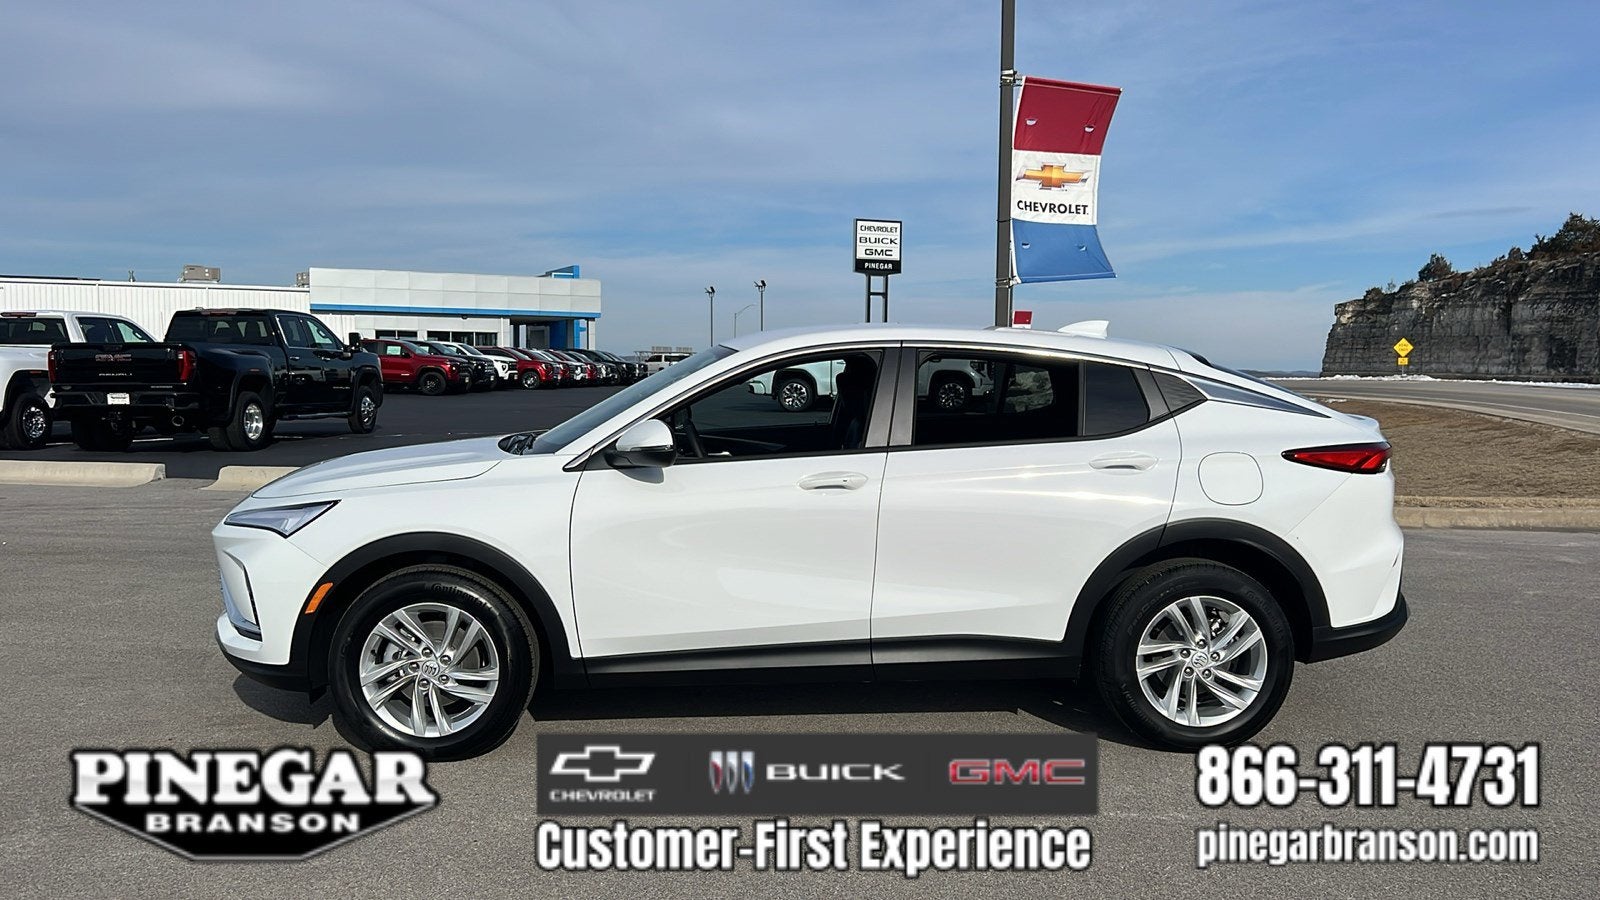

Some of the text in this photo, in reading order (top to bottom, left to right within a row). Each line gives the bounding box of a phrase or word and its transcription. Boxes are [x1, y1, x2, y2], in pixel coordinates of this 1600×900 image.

[860, 225, 898, 233] CHEVROLET
[859, 236, 898, 245] BUICK
[864, 248, 893, 257] GMC
[864, 262, 893, 270] PINEGAR
